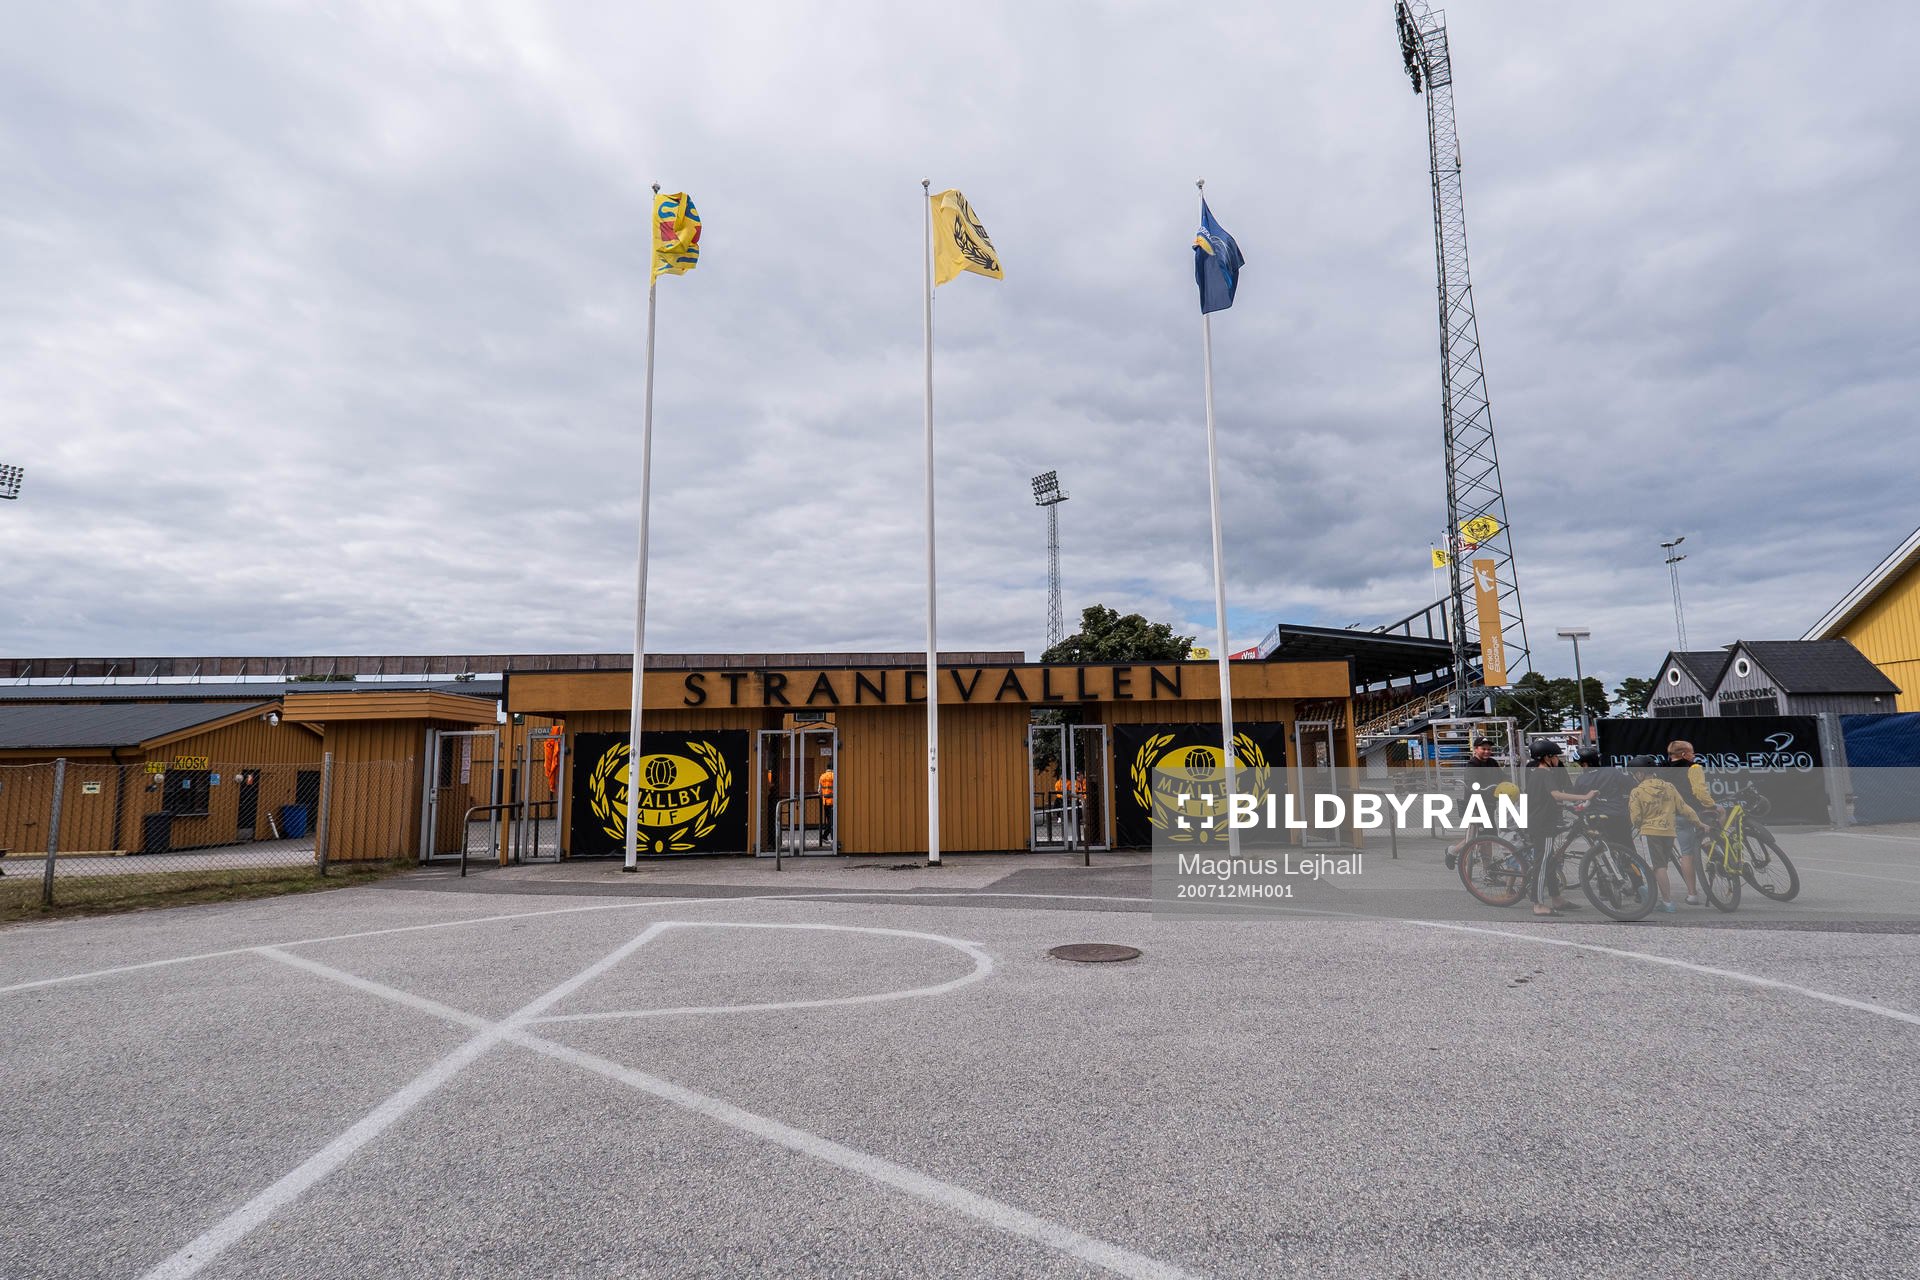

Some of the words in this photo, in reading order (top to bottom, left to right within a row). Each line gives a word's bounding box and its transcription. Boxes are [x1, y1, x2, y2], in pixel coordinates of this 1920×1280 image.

[684, 666, 1182, 706] STRANDVALLEN
[1653, 694, 1703, 706] SÖLVESBORG
[1718, 687, 1777, 702] SÖLVESBORG
[175, 757, 207, 769] KIOSK
